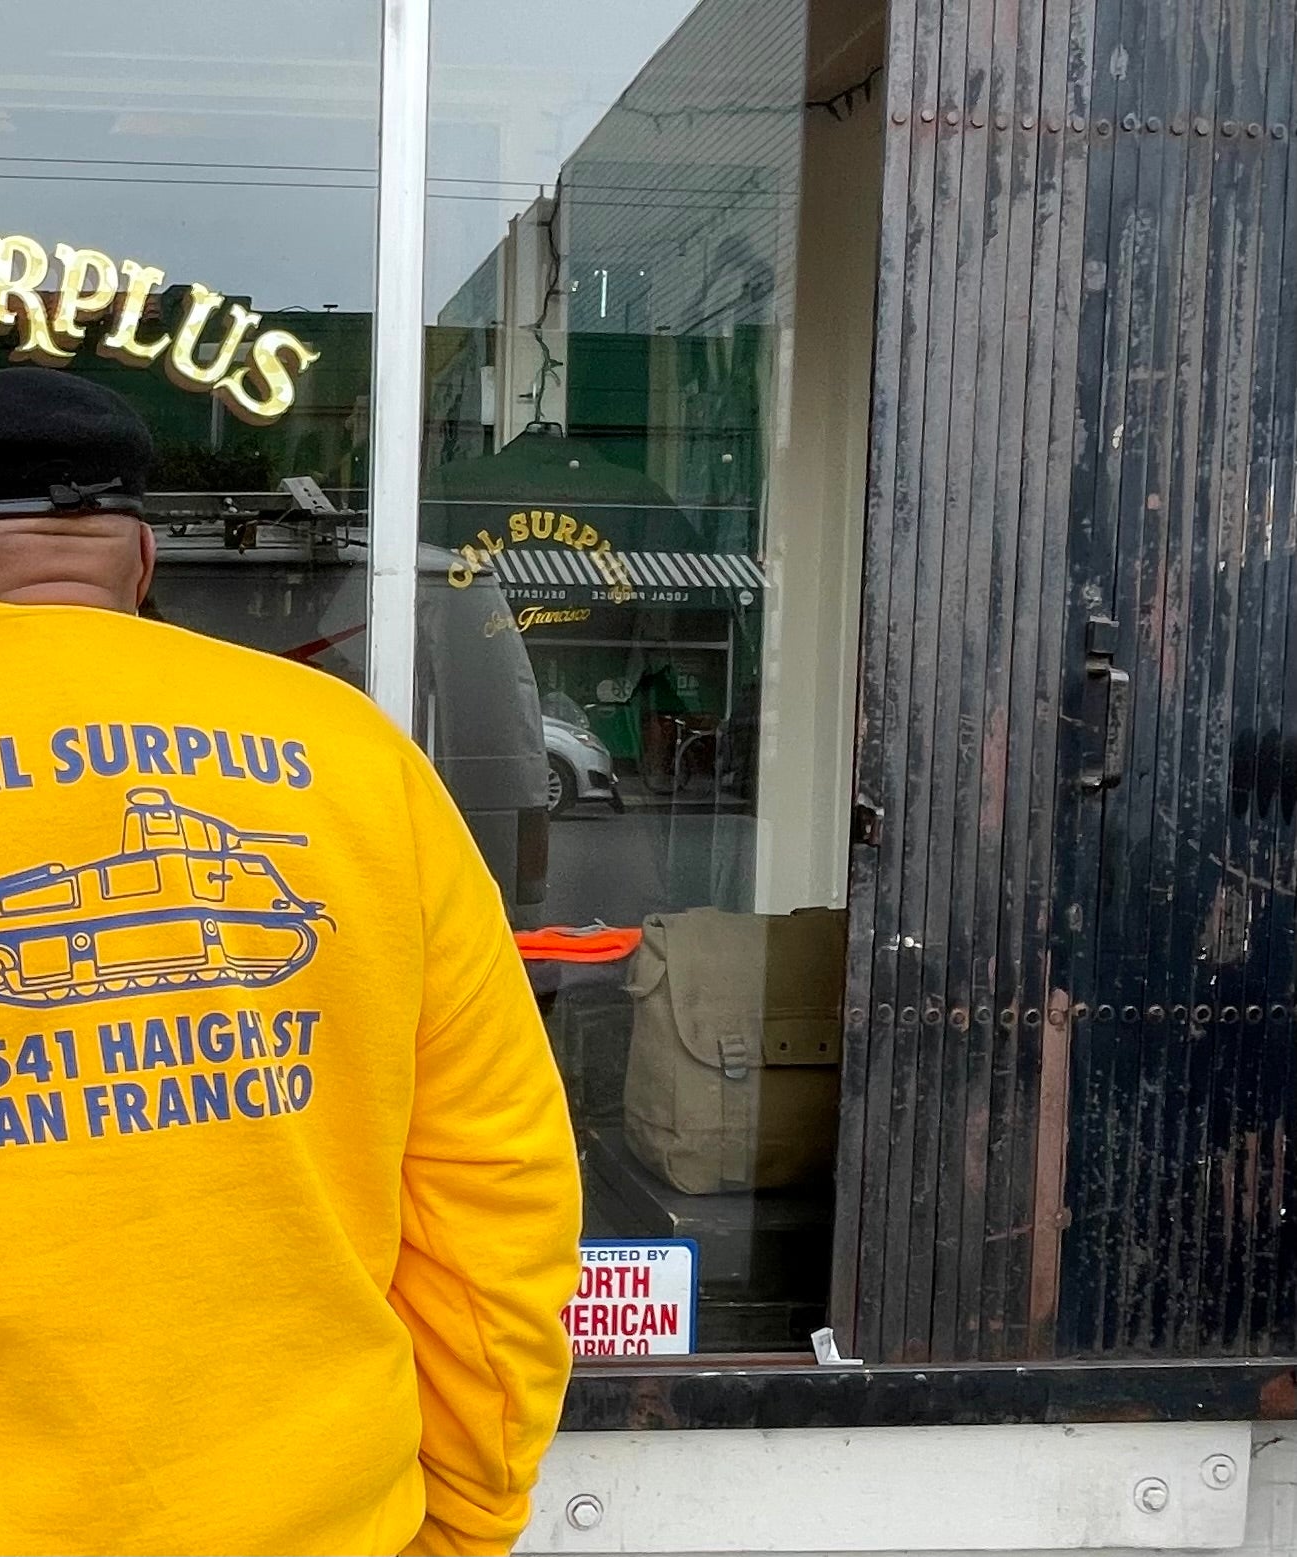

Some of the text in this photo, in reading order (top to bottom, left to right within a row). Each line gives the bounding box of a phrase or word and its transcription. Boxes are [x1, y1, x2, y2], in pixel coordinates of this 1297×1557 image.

[517, 606, 591, 632] Francisco
[50, 724, 314, 788] SURPLUS
[98, 1010, 268, 1075] HAIGH
[273, 1010, 321, 1059] ST
[83, 1064, 314, 1138] FRANCIO
[580, 1249, 670, 1261] TECTED BY
[576, 1266, 651, 1299] ORTH
[560, 1304, 678, 1336] ERICAN
[573, 1339, 616, 1356] ARM
